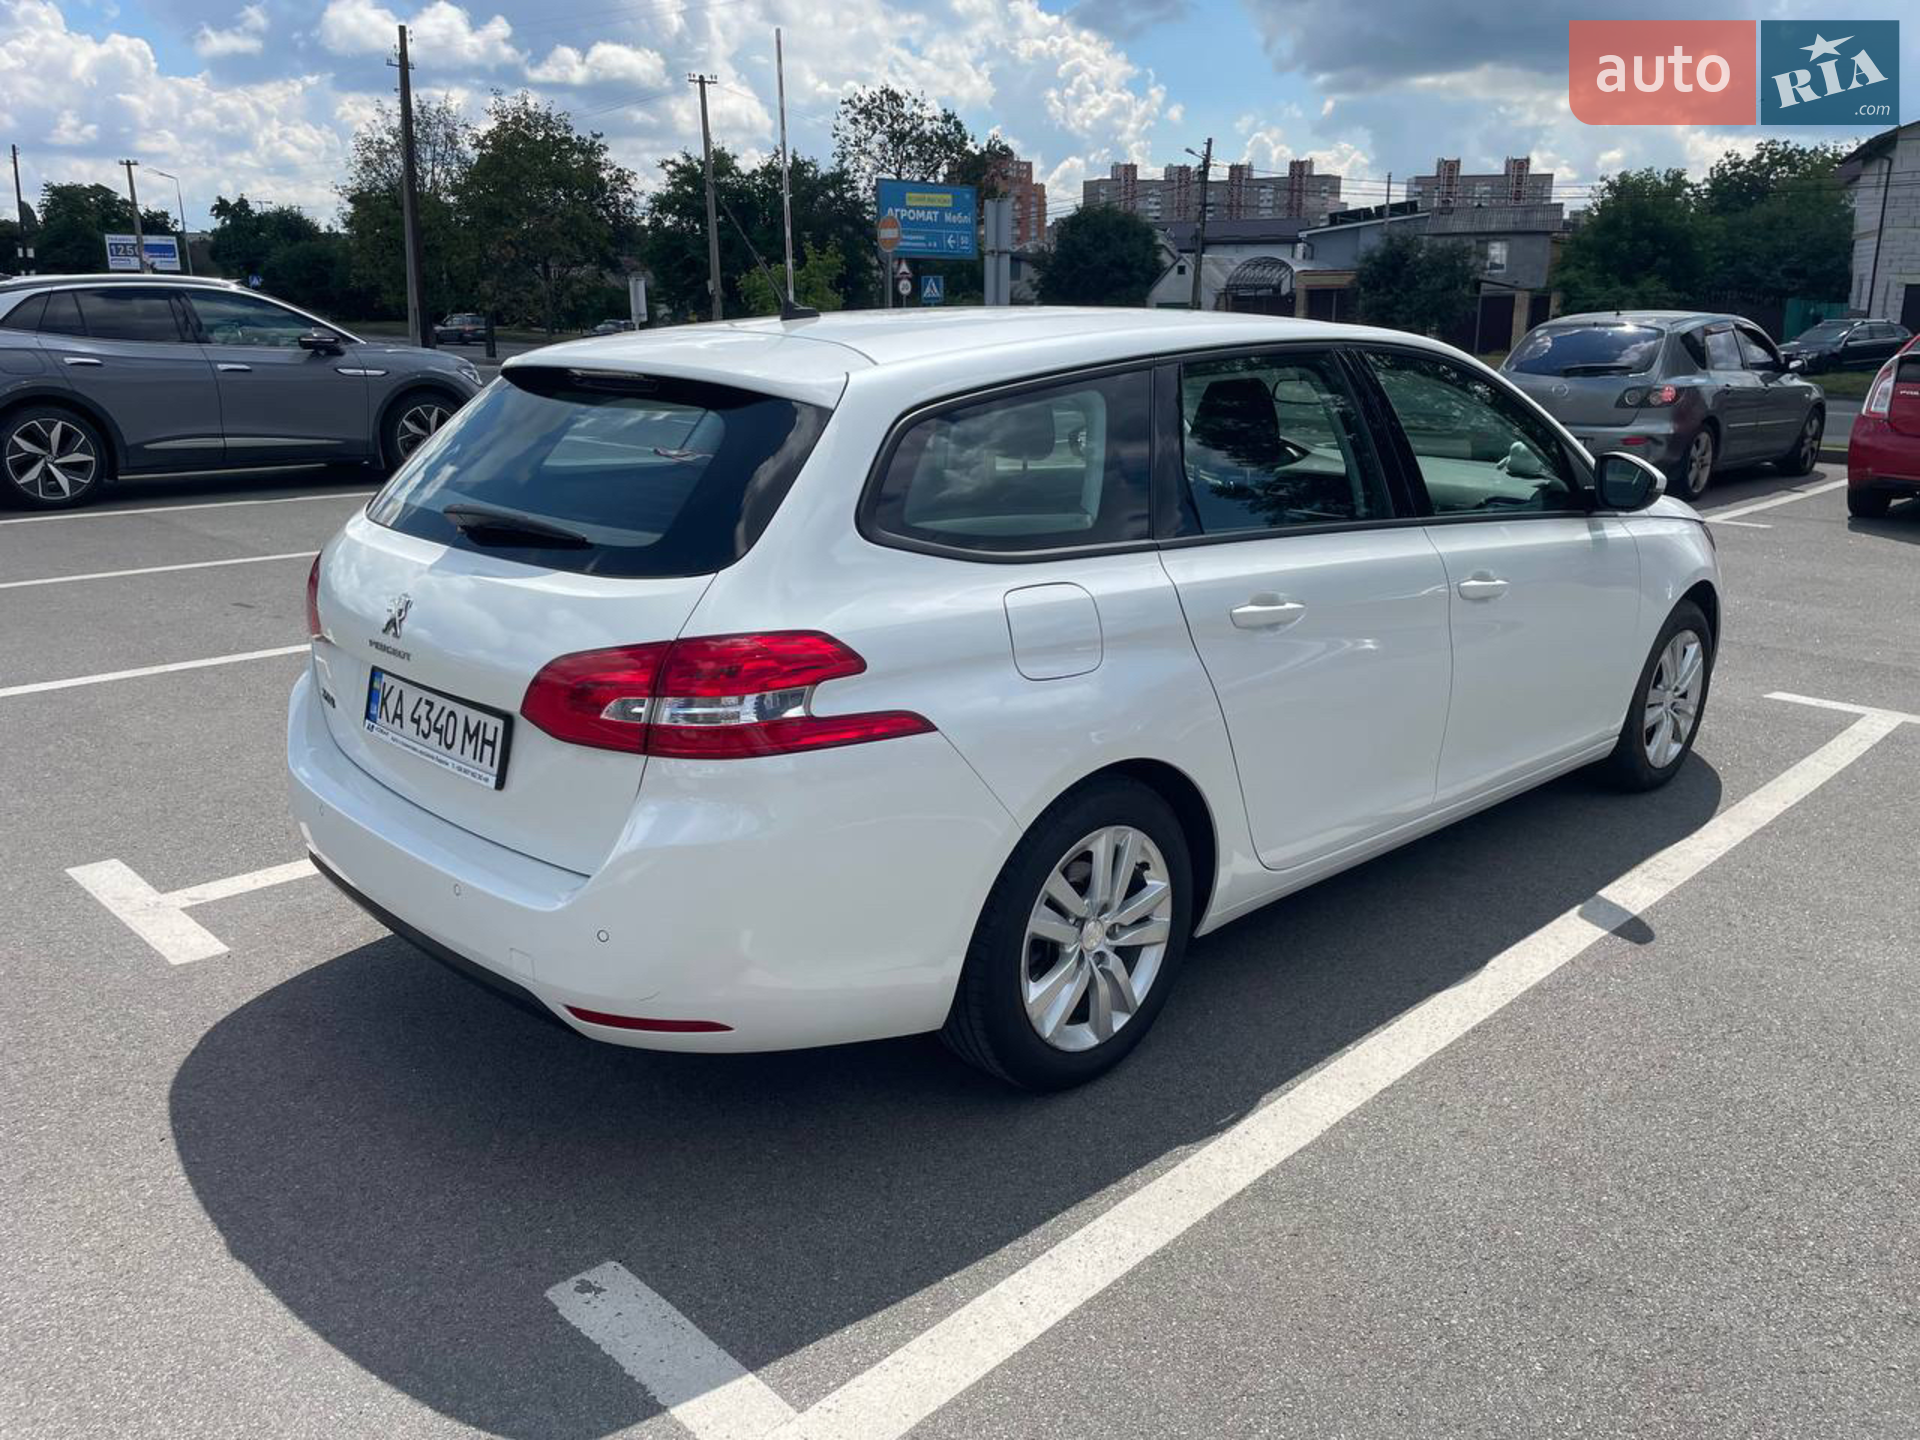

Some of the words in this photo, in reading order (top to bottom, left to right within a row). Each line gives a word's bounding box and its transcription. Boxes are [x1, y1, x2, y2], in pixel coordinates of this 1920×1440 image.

[886, 207, 939, 223] АГРОМАТ
[379, 682, 404, 729] KA
[410, 697, 458, 750] 4340
[460, 715, 499, 768] MH
